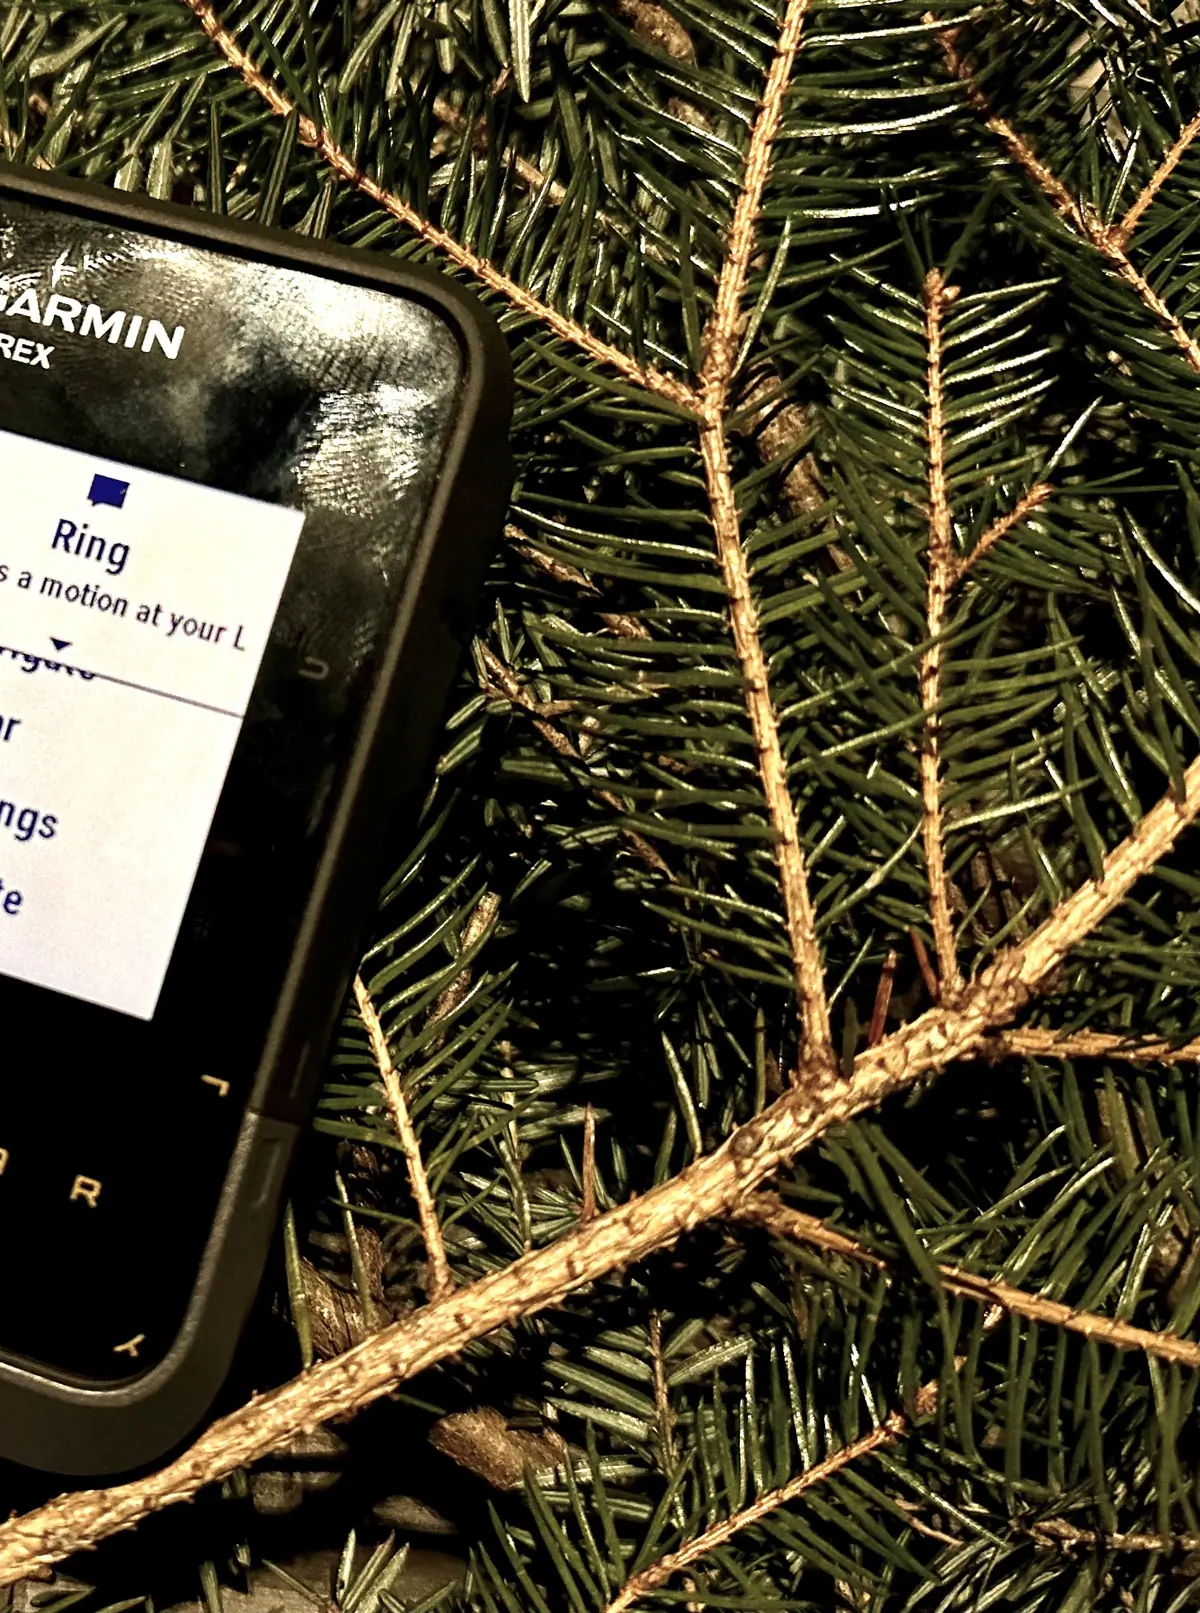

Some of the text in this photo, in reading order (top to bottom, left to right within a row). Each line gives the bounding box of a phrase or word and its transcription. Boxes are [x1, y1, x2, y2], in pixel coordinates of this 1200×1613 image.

[51, 518, 131, 575] Ring
[17, 571, 33, 589] a
[39, 576, 129, 618] motion
[135, 603, 163, 628] at
[167, 612, 228, 644] your
[232, 624, 247, 652] L
